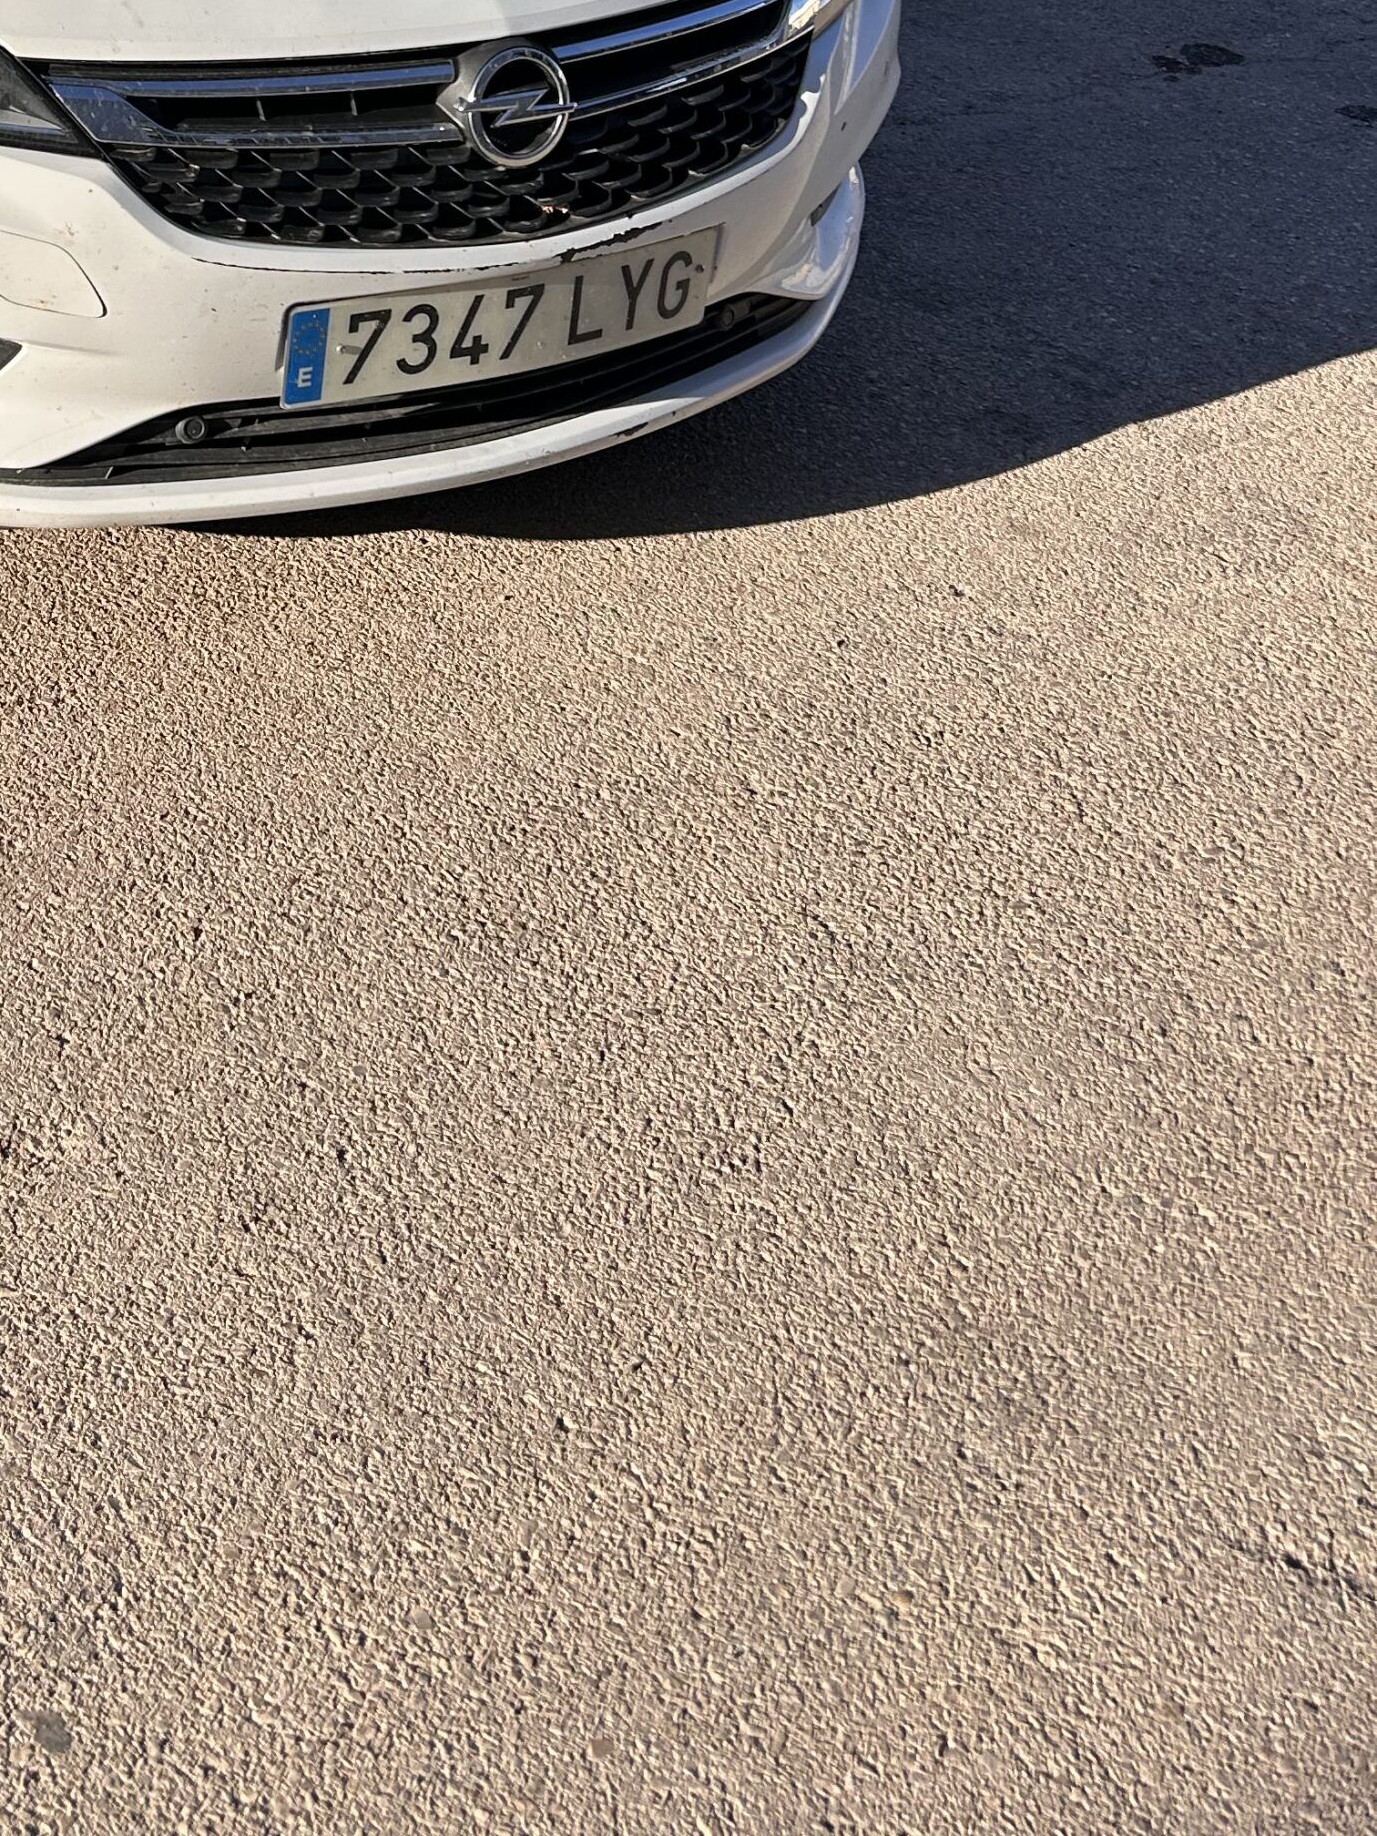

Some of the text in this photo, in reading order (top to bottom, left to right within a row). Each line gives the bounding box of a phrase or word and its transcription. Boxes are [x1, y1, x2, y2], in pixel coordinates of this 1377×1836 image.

[342, 250, 694, 386] 7347 LYG
[297, 366, 314, 388] E
